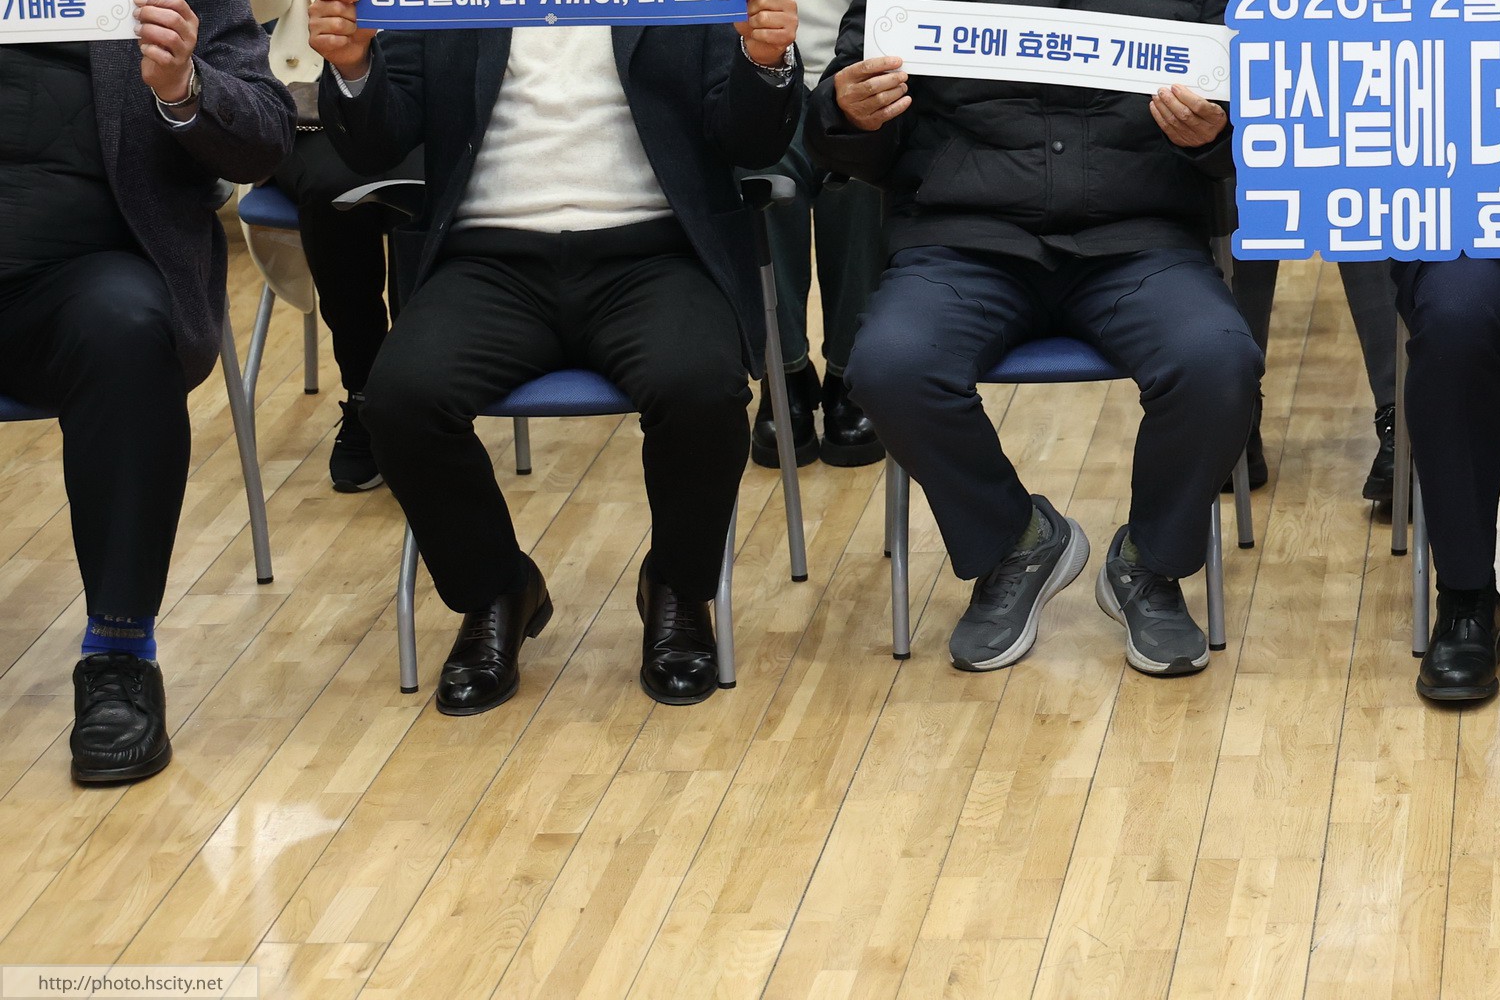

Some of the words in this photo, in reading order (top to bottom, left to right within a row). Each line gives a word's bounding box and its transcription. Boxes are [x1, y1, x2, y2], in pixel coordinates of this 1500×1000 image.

[915, 25, 941, 51] 그
[953, 27, 1007, 56] 안에
[1017, 31, 1099, 63] 효행구
[1111, 39, 1190, 74] 기배동
[1240, 40, 1456, 178] 당신곁에,
[1242, 191, 1304, 249] 그
[1328, 188, 1450, 251] 안에
